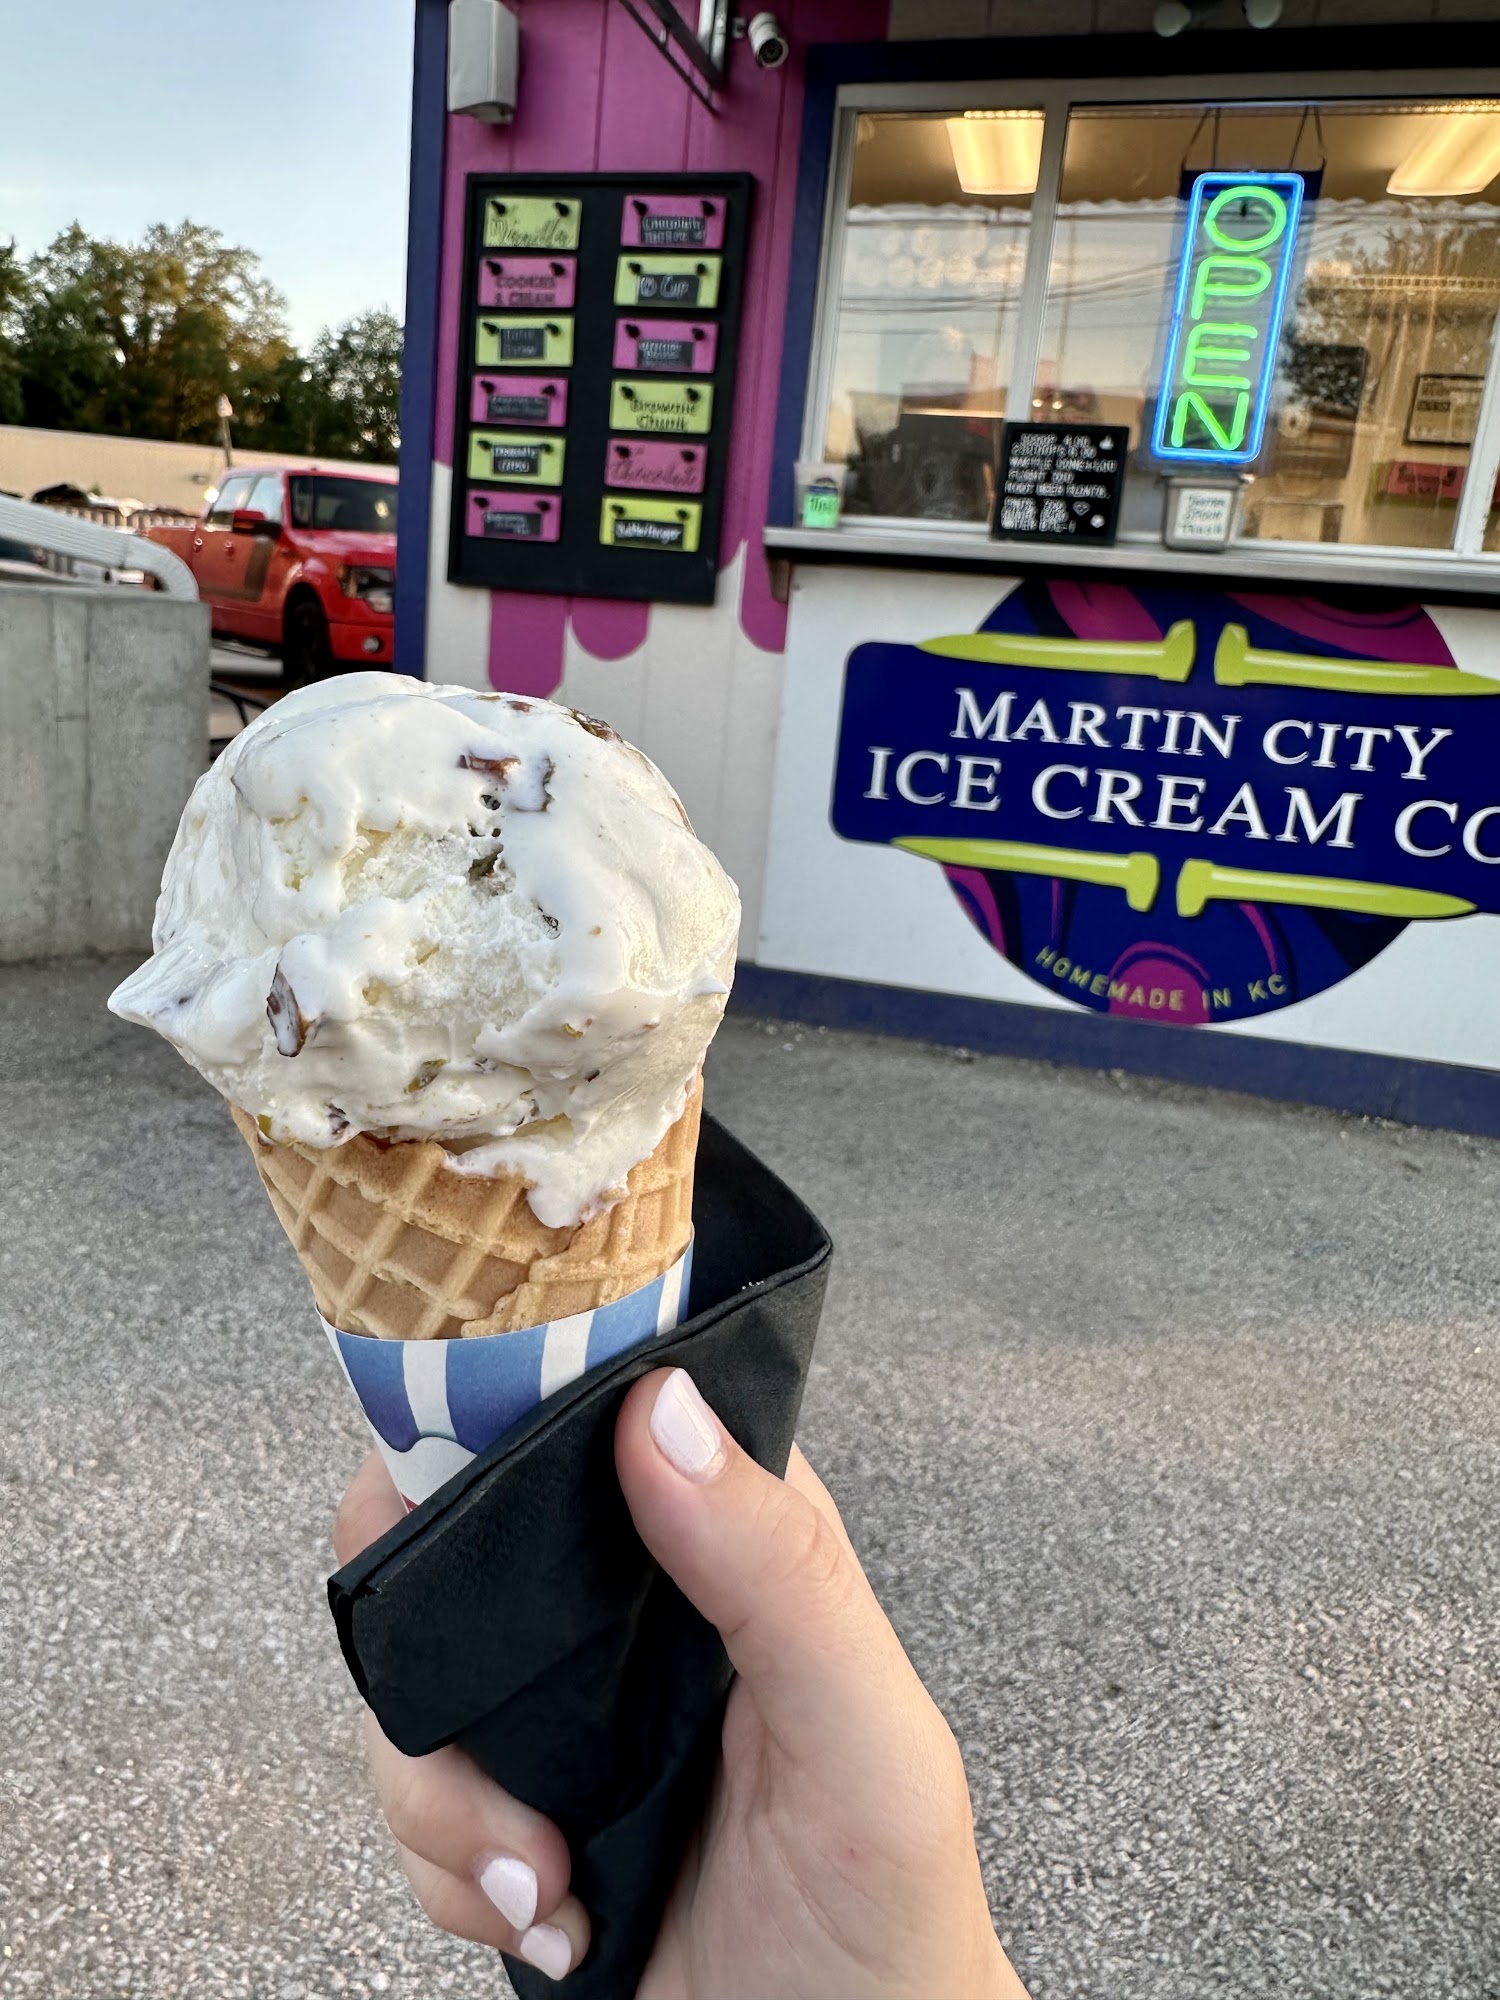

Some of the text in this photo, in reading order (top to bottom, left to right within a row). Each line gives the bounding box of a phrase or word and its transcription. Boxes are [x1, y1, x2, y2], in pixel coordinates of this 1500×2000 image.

[1171, 185, 1288, 452] OPEN
[949, 687, 1454, 781] MARTIN CITY
[862, 746, 1003, 812] ICE
[1030, 764, 1364, 849] CREAM
[1034, 944, 1287, 1013] HOMEMADE IN KC
